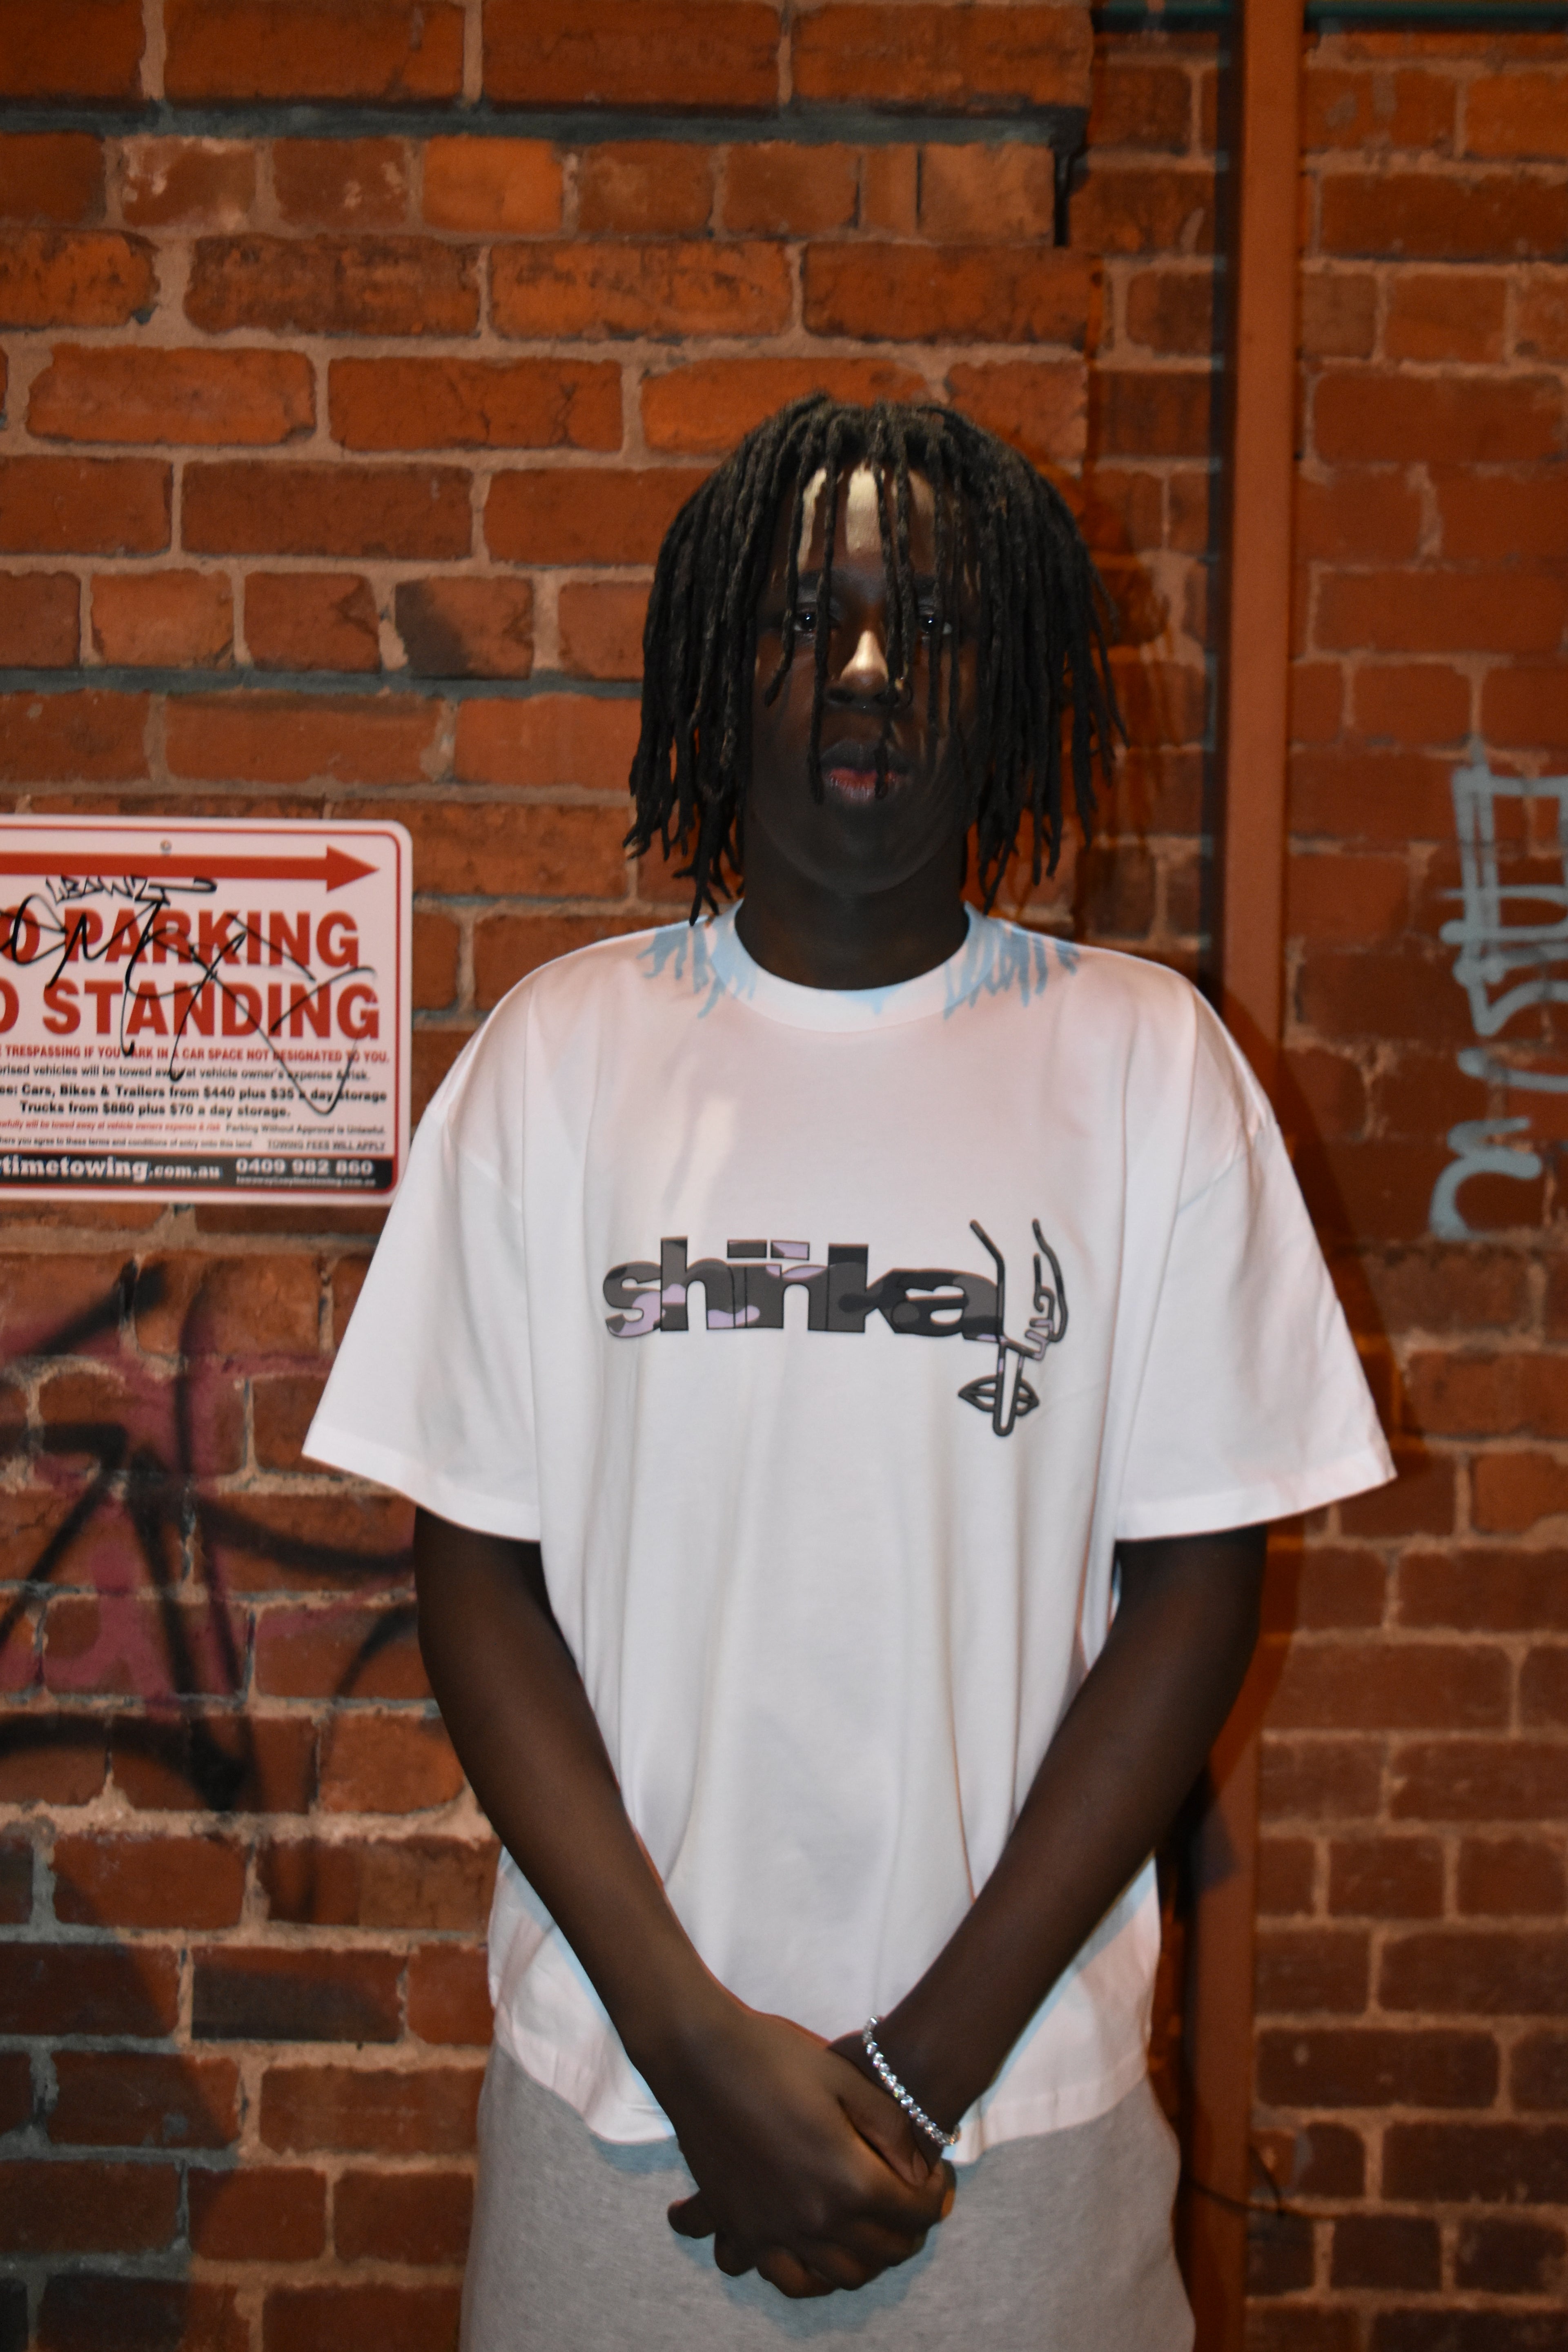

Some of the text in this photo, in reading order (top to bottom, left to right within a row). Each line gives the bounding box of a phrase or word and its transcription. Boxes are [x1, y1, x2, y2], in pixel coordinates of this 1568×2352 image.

[65, 907, 359, 968] PARKING
[43, 977, 379, 1040] STANDING
[6, 1044, 80, 1058] TRESPASSING
[85, 1045, 94, 1058] IF
[98, 1046, 120, 1058] YOU
[157, 1047, 168, 1059] IN
[183, 1047, 204, 1060] CAR
[209, 1047, 242, 1060] SPACE
[247, 1048, 268, 1060] NOT
[273, 1049, 342, 1062] DESIGNATED
[364, 1050, 389, 1062] YOU.
[33, 1063, 78, 1076] vehicles
[81, 1064, 99, 1076] will
[103, 1065, 116, 1076] be
[119, 1065, 151, 1077] towed
[186, 1066, 196, 1078] at
[200, 1066, 238, 1078] vehicle
[241, 1067, 283, 1079] owner's
[22, 1083, 55, 1098] Cars,
[60, 1083, 96, 1096] Bikes
[101, 1084, 109, 1096] &
[116, 1084, 165, 1097] Trailers
[170, 1085, 199, 1098] from
[204, 1086, 235, 1098] $440
[239, 1086, 265, 1101] plus
[310, 1087, 334, 1102] day
[337, 1088, 387, 1103] storage
[20, 1100, 64, 1113] Trucks
[69, 1101, 98, 1114] from
[138, 1102, 165, 1117] plus
[170, 1103, 193, 1115] $70
[198, 1106, 205, 1115] a
[210, 1103, 232, 1118] day
[238, 1104, 291, 1119] storage.
[0, 1154, 223, 1183] timetowing.com.au
